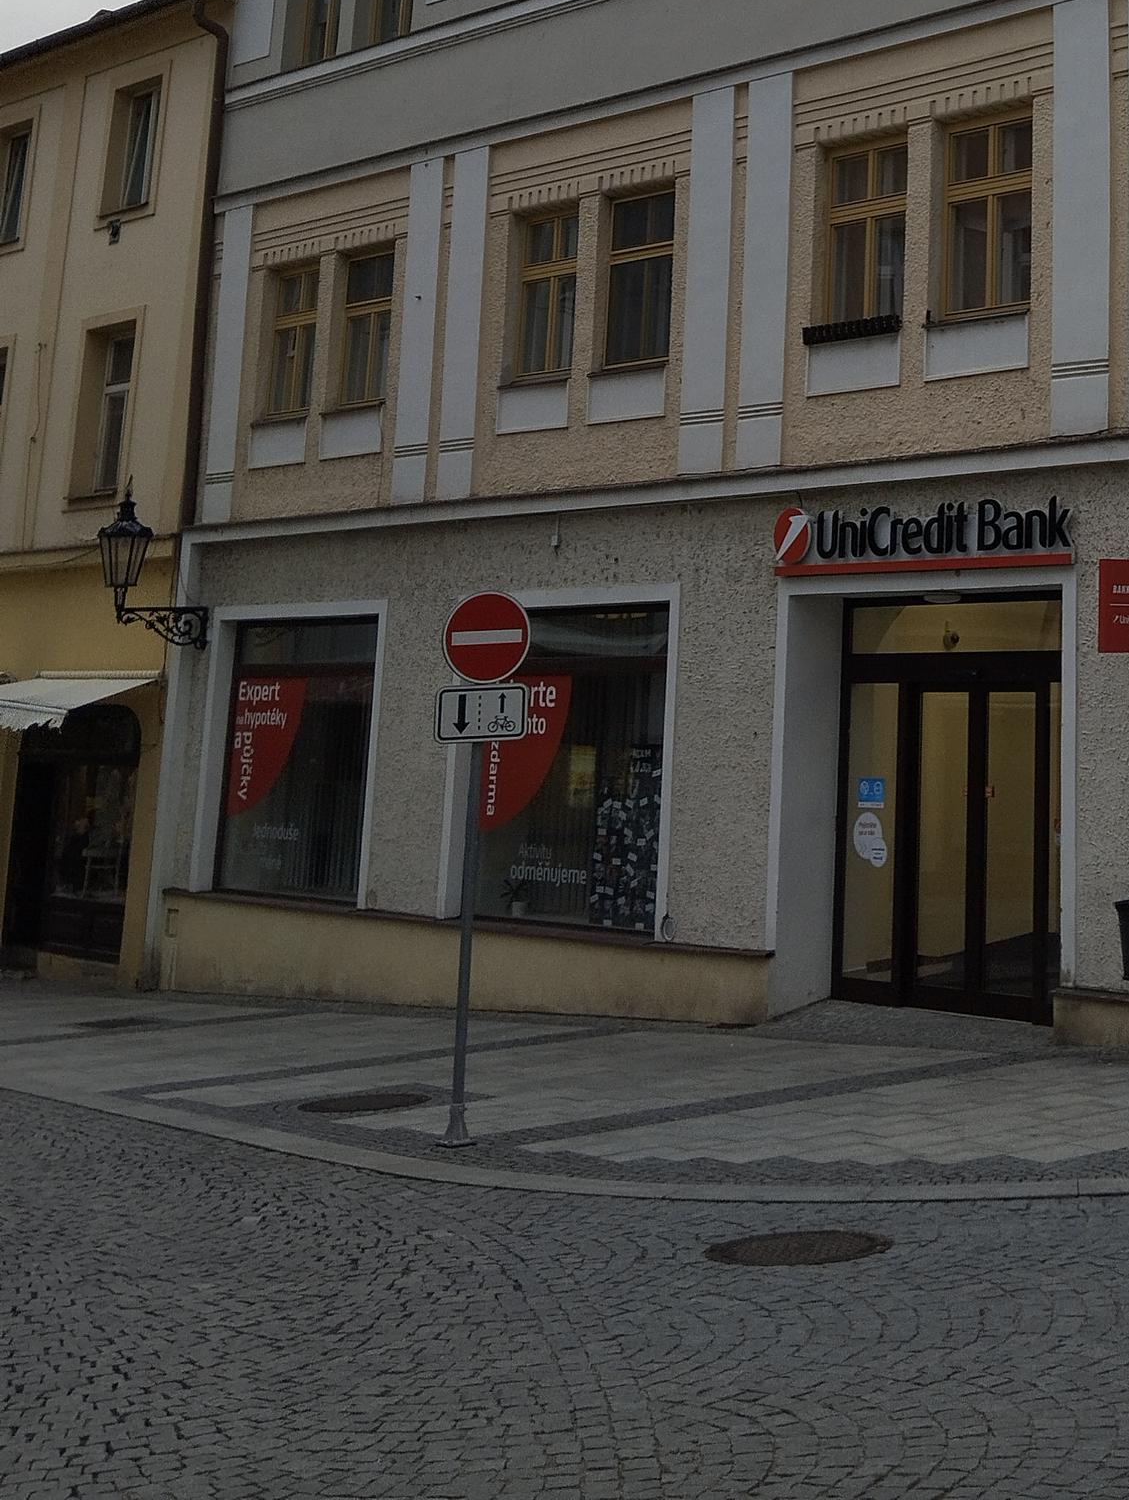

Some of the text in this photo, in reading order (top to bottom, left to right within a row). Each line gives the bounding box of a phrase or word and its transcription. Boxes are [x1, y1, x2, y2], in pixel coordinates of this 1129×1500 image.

[816, 495, 1071, 560] UniCredit Bank
[238, 680, 281, 706] Expert
[244, 708, 288, 730] hypotéky
[234, 730, 255, 801] a půjčky
